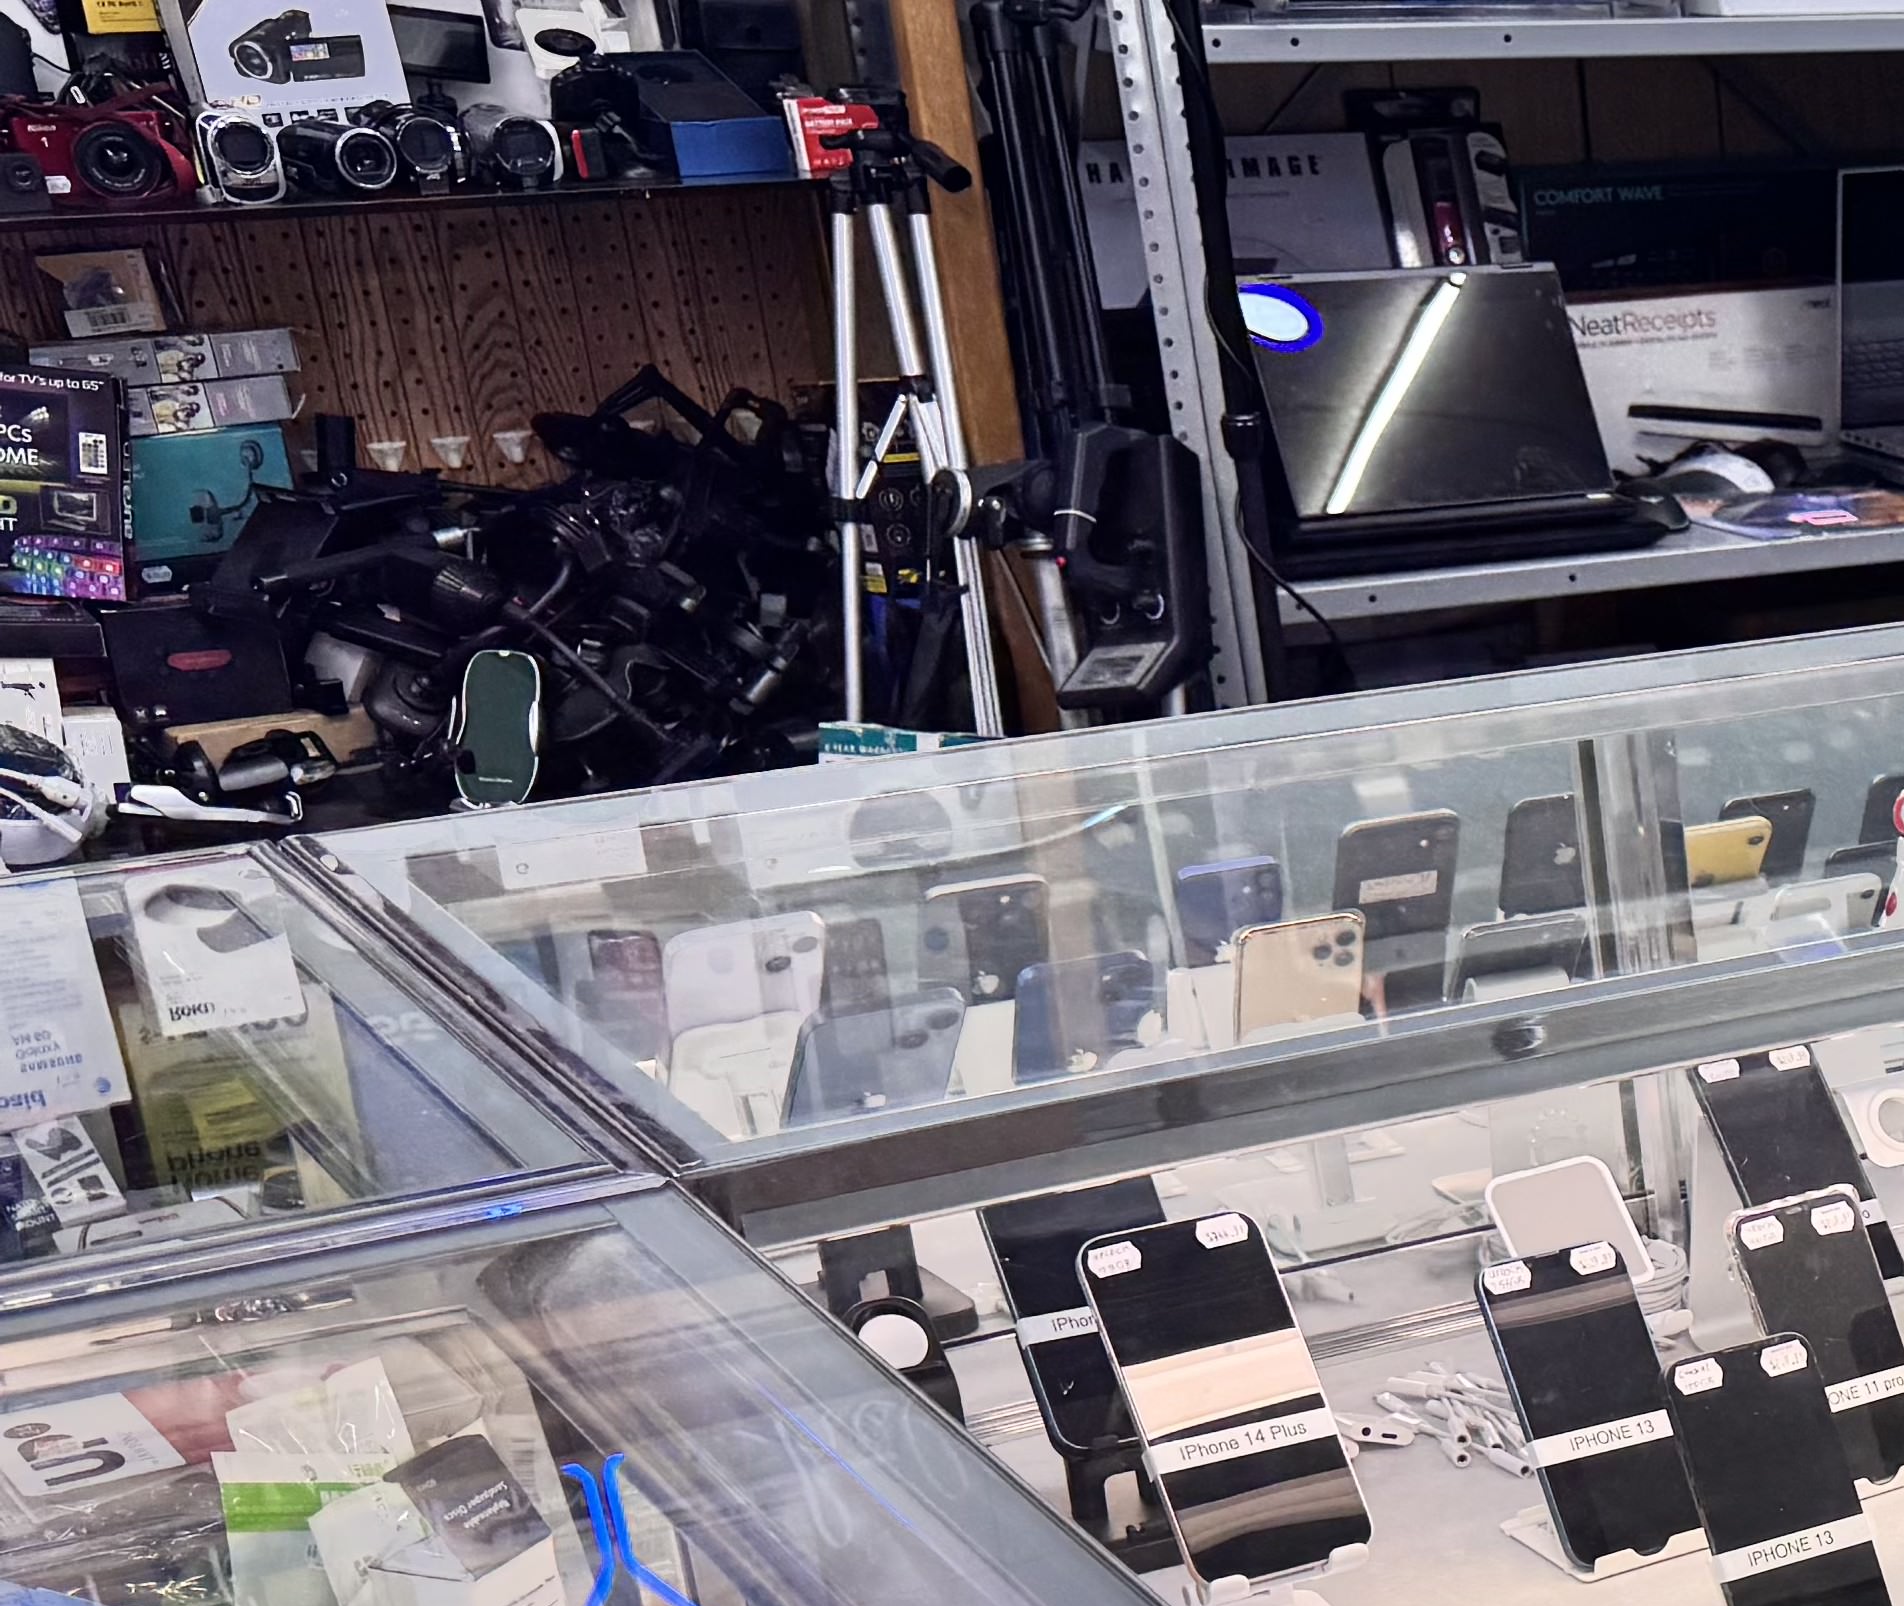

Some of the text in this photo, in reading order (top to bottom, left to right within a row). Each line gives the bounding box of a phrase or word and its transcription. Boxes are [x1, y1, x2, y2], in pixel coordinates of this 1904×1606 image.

[1534, 184, 1665, 207] COMFORT WAVE
[1826, 1375, 1904, 1408] ONE 11 pro
[1243, 1420, 1308, 1446] 14 Plus
[1569, 1418, 1656, 1452] IPHONE 13
[1746, 1530, 1835, 1568] IPHONE 13
